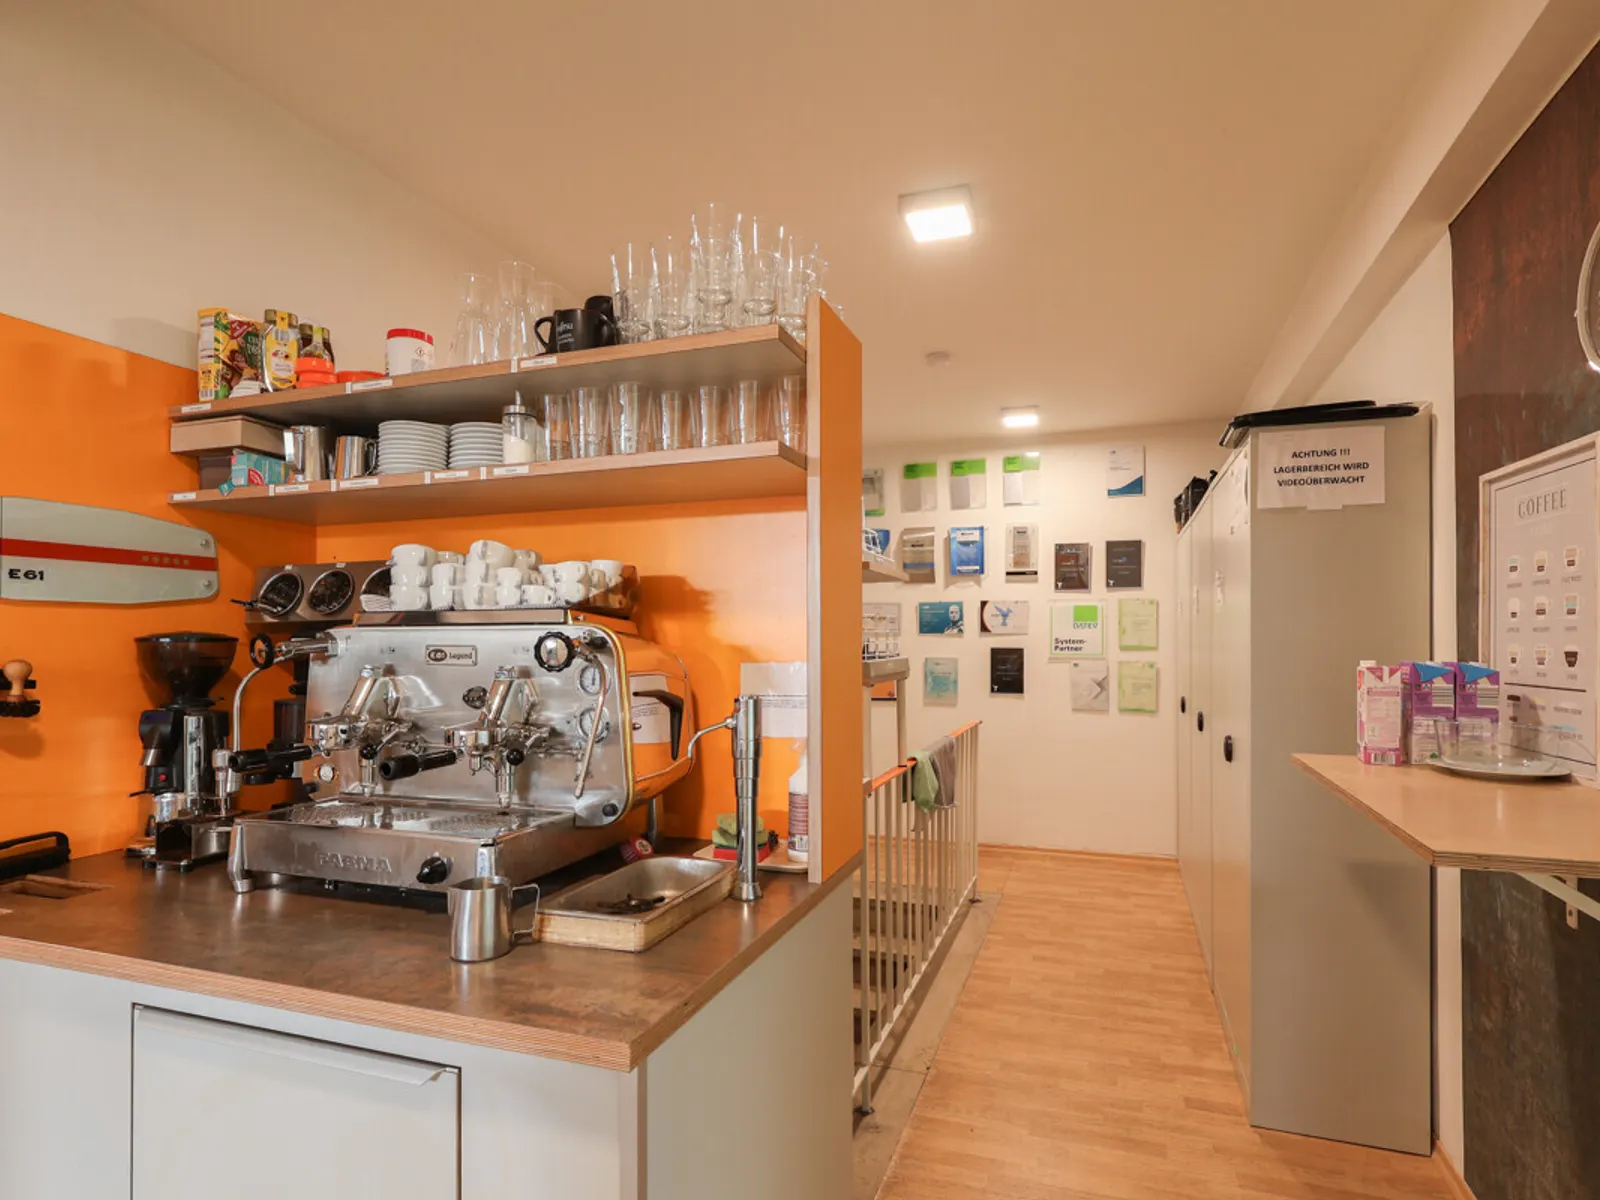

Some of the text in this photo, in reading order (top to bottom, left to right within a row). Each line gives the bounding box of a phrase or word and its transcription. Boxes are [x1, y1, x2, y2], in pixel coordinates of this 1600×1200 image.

[1291, 448, 1350, 459] ACHTUNG !!!
[1273, 462, 1369, 474] LAGERBEREICH WIRD
[1276, 475, 1365, 487] VIDEOÜBERWACHT
[1517, 488, 1567, 519] COFFEE
[1054, 637, 1087, 646] System-
